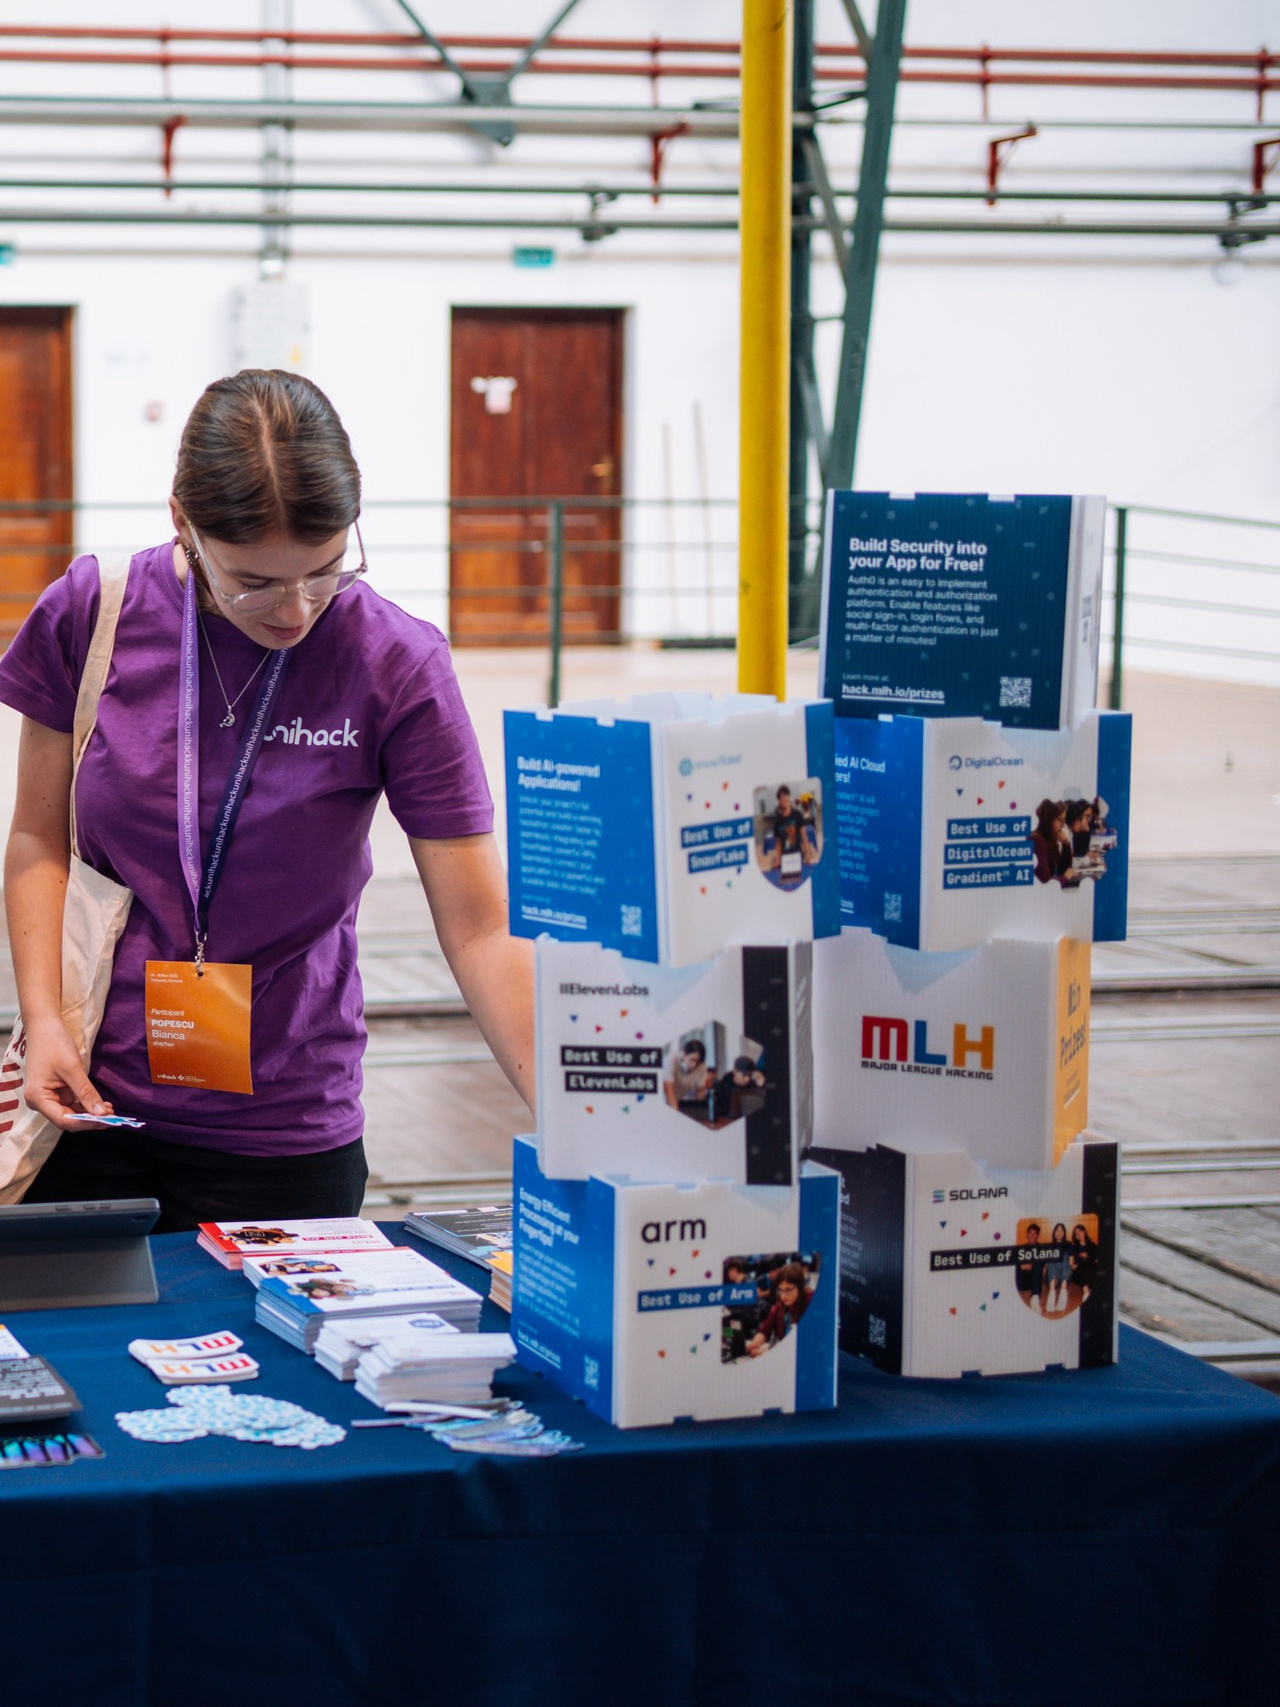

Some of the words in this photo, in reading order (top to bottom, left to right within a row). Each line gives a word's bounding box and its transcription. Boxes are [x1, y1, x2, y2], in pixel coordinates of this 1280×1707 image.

[850, 538, 887, 551] Build
[890, 539, 954, 556] Security
[957, 541, 987, 555] into
[849, 556, 883, 570] your
[886, 555, 917, 572] App
[920, 556, 942, 570] for
[945, 557, 984, 571] Free!
[878, 576, 885, 585] is
[888, 578, 899, 586] an
[902, 579, 923, 588] easy
[938, 579, 987, 589] implement
[847, 588, 912, 598] authentication
[915, 590, 933, 598] and
[935, 591, 997, 601] authorization
[846, 599, 886, 609] platform.
[889, 600, 921, 610] Enable
[923, 601, 962, 611] features
[964, 603, 980, 612] like
[846, 610, 872, 619] social
[875, 611, 908, 622] sign-in,
[911, 612, 933, 622] login
[936, 614, 963, 624] flows,
[966, 615, 984, 624] and
[845, 621, 898, 631] multi-factor
[901, 623, 968, 635] authentication
[970, 626, 979, 635] in
[981, 627, 998, 637] just
[853, 634, 883, 642] matter
[885, 634, 895, 643] of
[897, 635, 936, 645] minutes!
[842, 684, 944, 700] hack.mlh.io/prizes
[860, 757, 886, 773] Cloud
[965, 755, 1023, 770] DigitalOcean
[683, 827, 709, 845] Best
[712, 823, 733, 841] Use
[737, 820, 753, 837] of
[950, 822, 981, 835] Best
[985, 821, 1007, 833] Use
[1012, 819, 1028, 833] of
[689, 846, 746, 871] Snowflake
[947, 845, 1031, 861] DigitalOcean
[1016, 868, 1030, 881] AI
[151, 1008, 184, 1016] Participant
[151, 1019, 194, 1029] POPESCU
[152, 1029, 185, 1040] Bianca
[861, 1015, 994, 1071] MLH
[565, 1050, 599, 1063] Best
[606, 1051, 631, 1064] Use
[640, 1050, 659, 1064] of
[861, 1061, 898, 1072] MAJOR
[901, 1064, 942, 1076] LEAGUE
[946, 1067, 993, 1080] HACKING
[569, 1075, 654, 1090] ElevenLabs
[949, 1187, 1008, 1201] SOLANA
[641, 1218, 707, 1244] arm
[934, 1255, 963, 1267] Best
[970, 1252, 990, 1264] Use
[997, 1251, 1012, 1263] of
[1018, 1248, 1060, 1261] Solana
[641, 1294, 672, 1308] Best
[679, 1291, 702, 1306] Use
[708, 1289, 724, 1303] of
[730, 1288, 753, 1302] Arm
[149, 1336, 236, 1354] MLH
[162, 1357, 252, 1375] MLH
